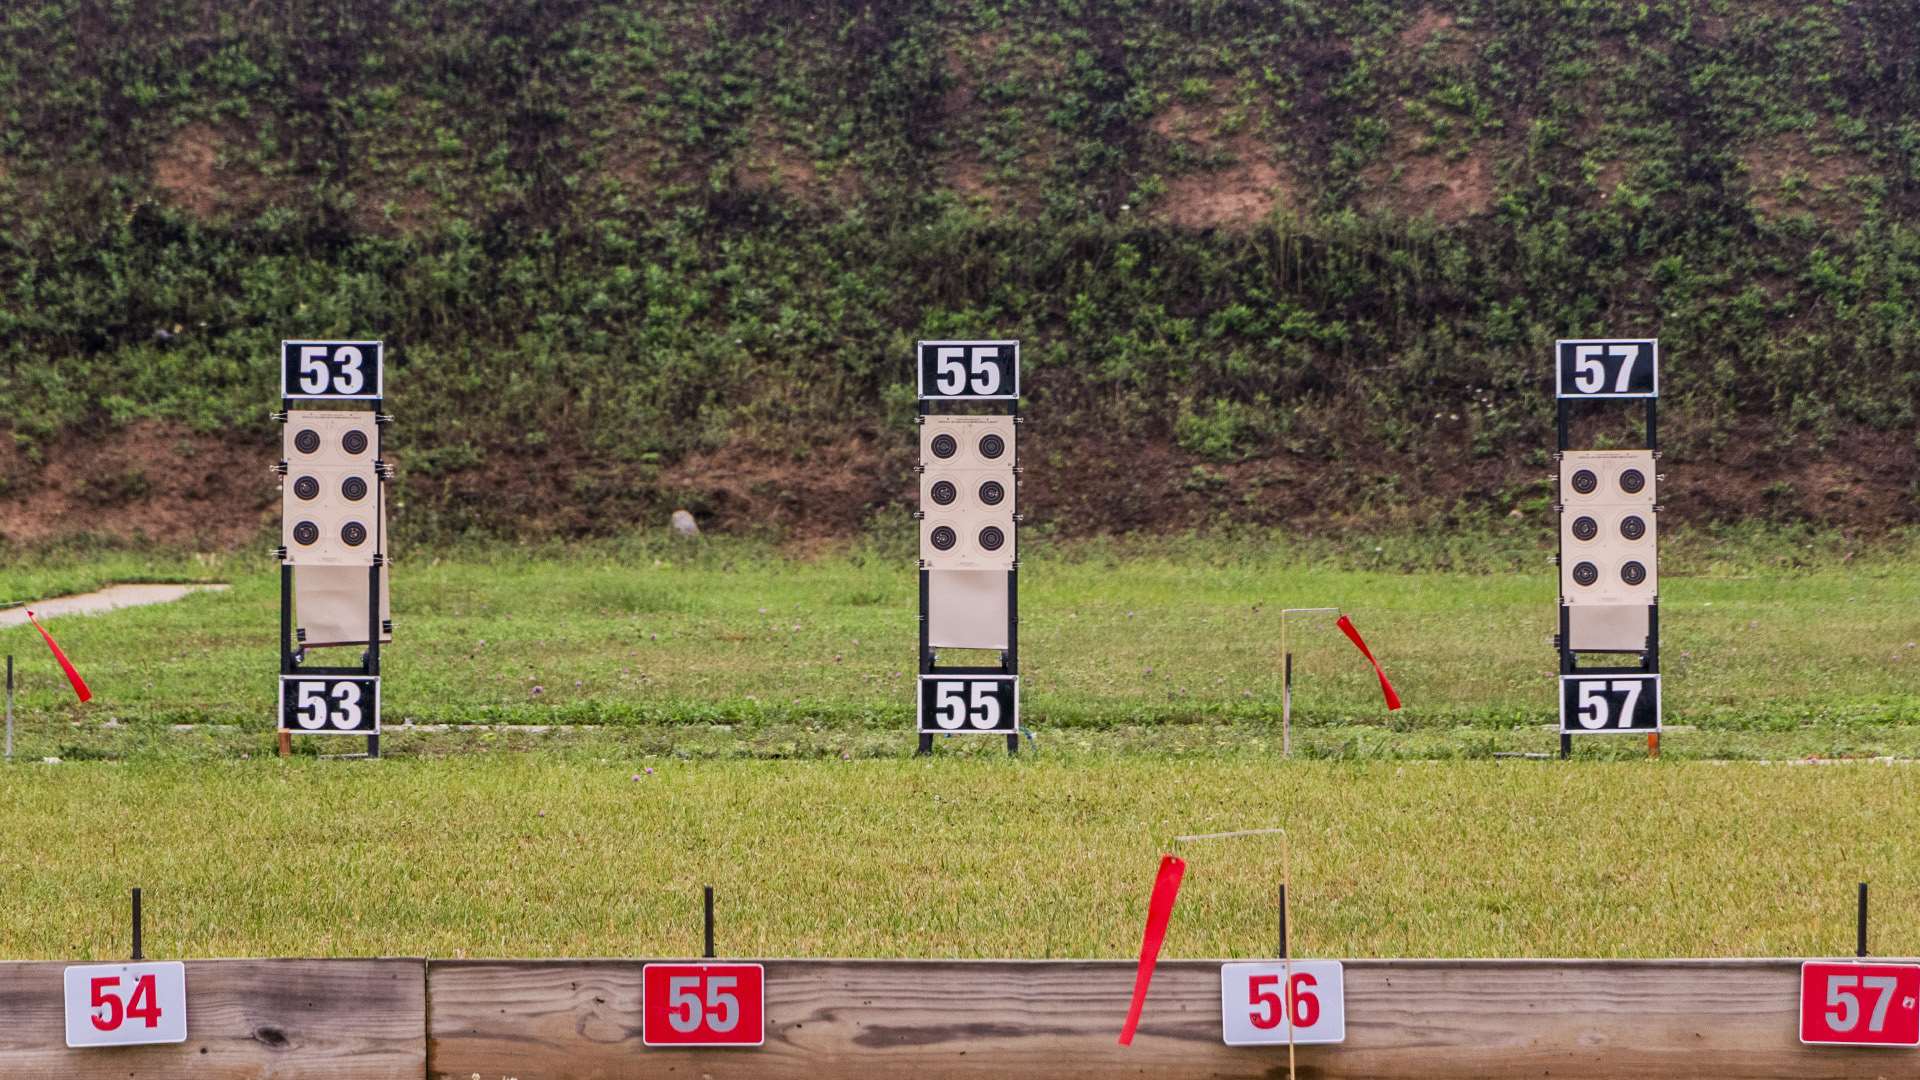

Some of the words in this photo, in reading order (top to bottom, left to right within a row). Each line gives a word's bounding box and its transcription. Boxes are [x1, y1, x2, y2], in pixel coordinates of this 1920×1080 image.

[299, 346, 364, 395] 53
[936, 347, 1001, 396] 55
[1574, 344, 1639, 394] 57
[297, 681, 362, 730] 53
[935, 681, 1001, 730] 55
[1578, 680, 1643, 730] 57
[90, 974, 163, 1032] 54
[668, 976, 740, 1033] 55
[1248, 972, 1321, 1030] 56
[1825, 975, 1898, 1032] 57
